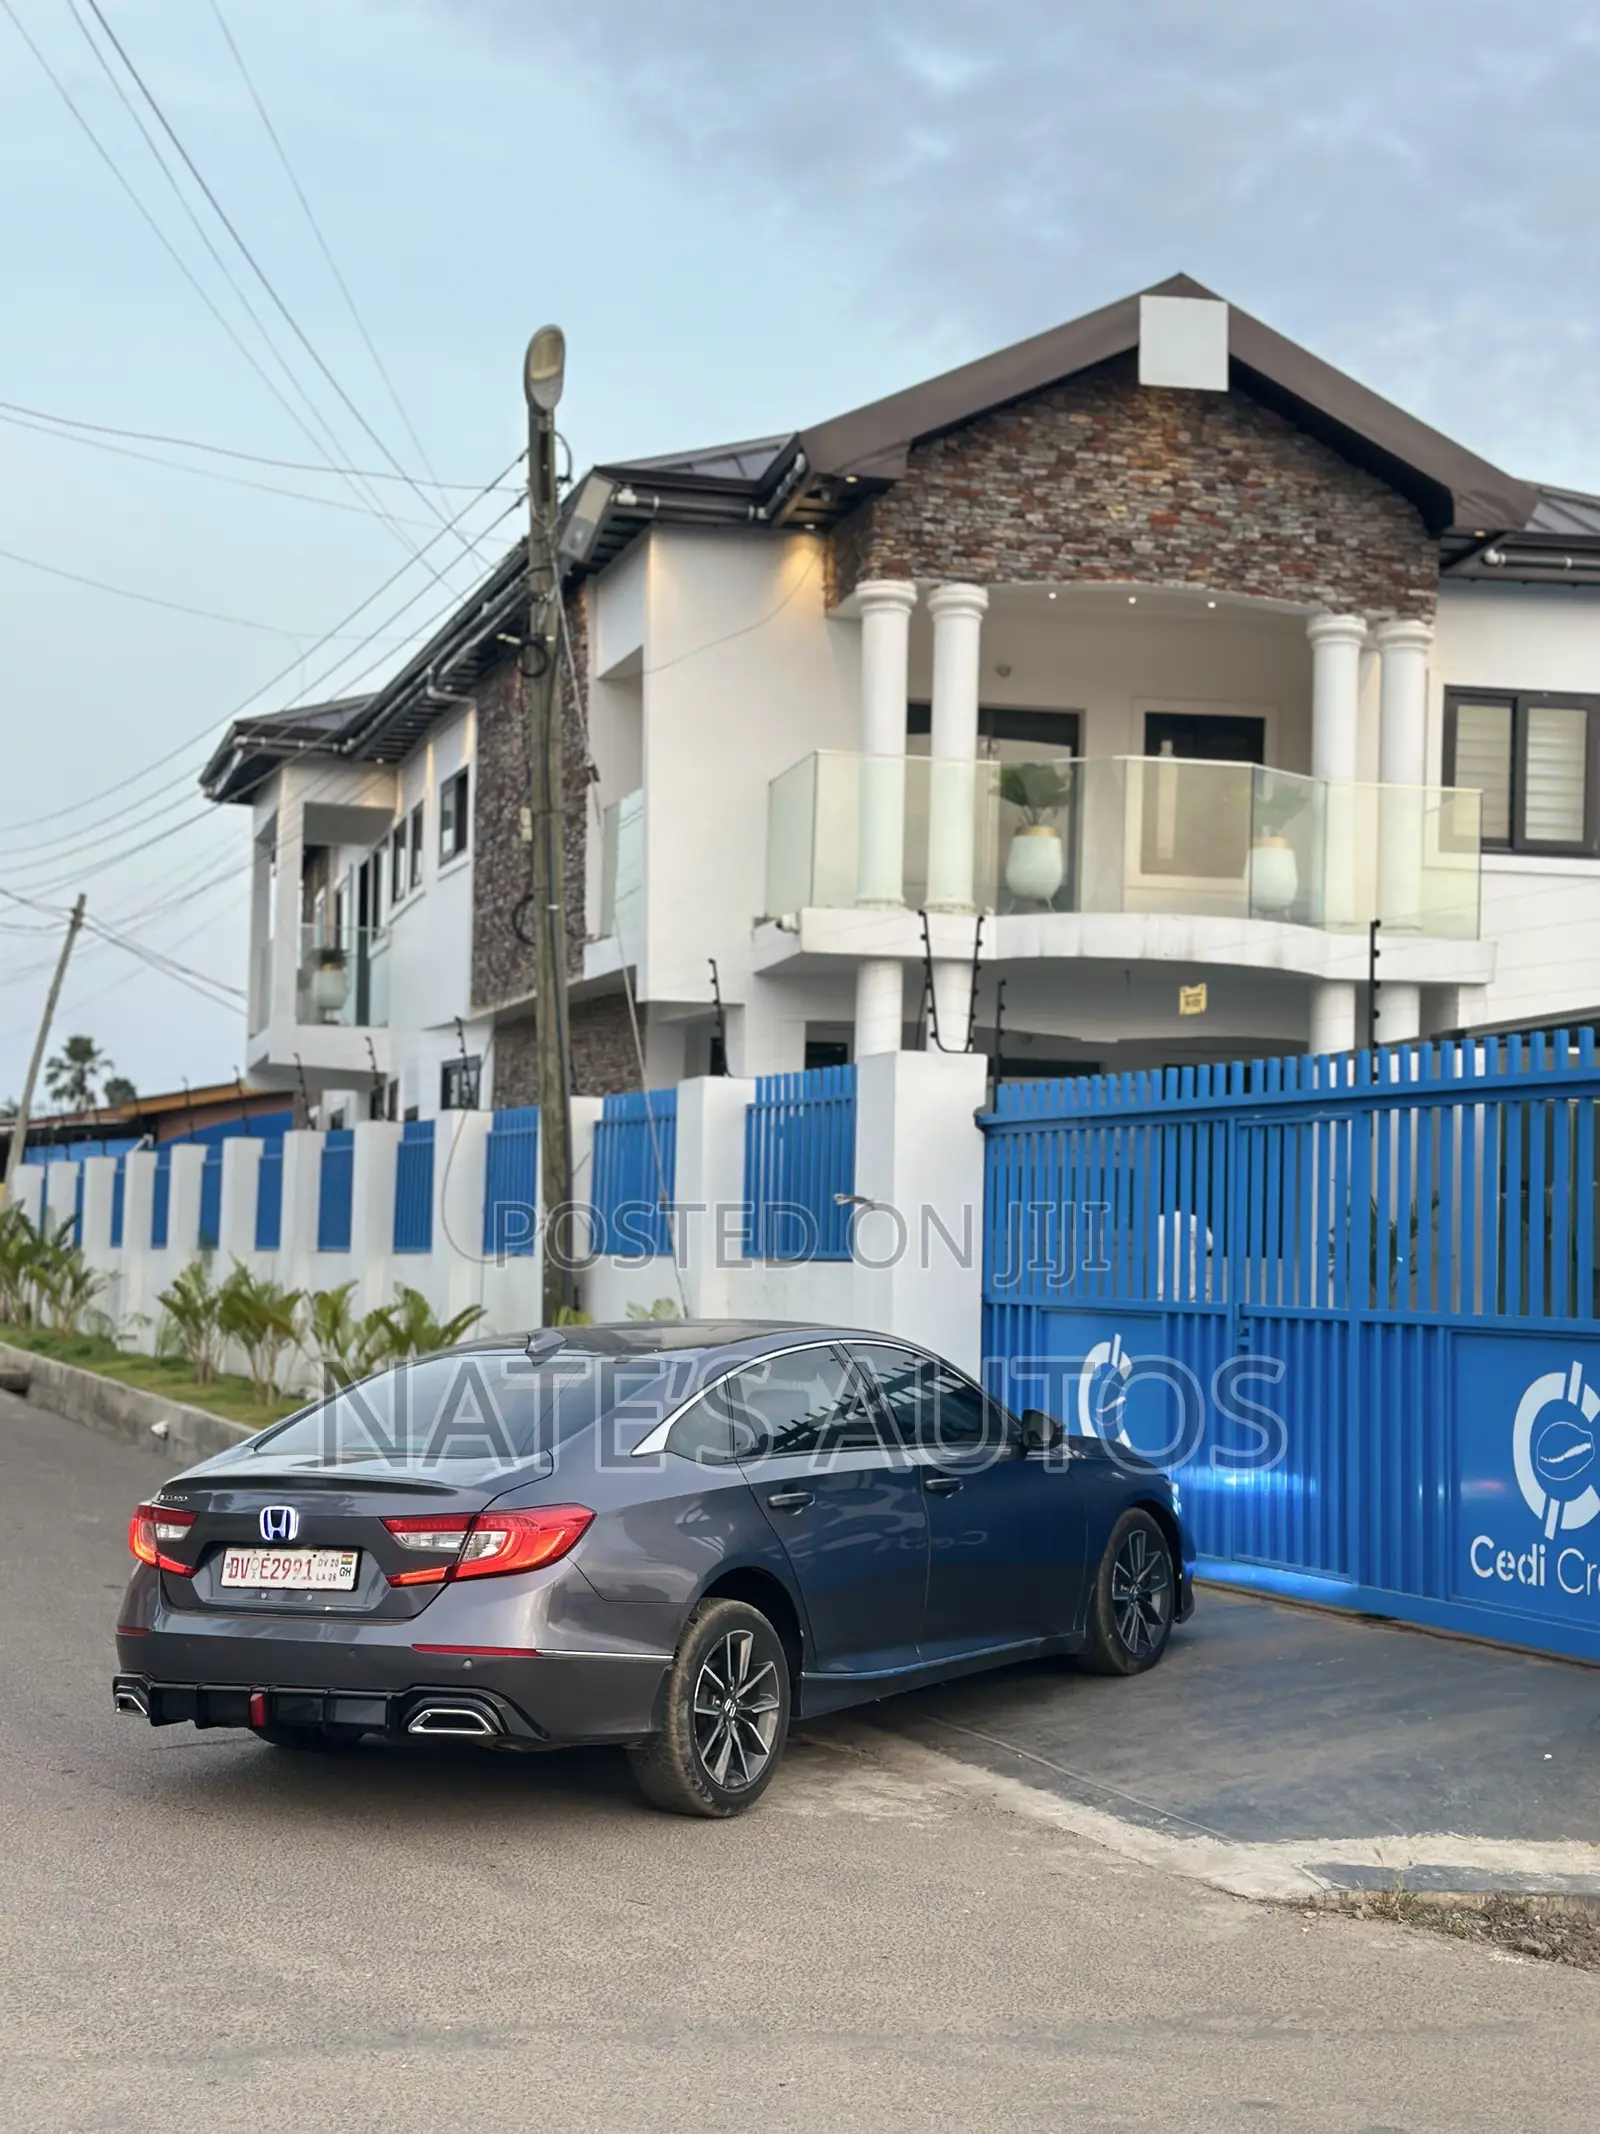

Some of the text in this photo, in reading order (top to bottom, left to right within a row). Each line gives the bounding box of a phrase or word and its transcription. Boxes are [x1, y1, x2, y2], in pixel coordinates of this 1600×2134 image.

[228, 1557, 251, 1579] DV
[339, 1566, 352, 1577] GH
[1470, 1534, 1600, 1596] Cedi Cr
